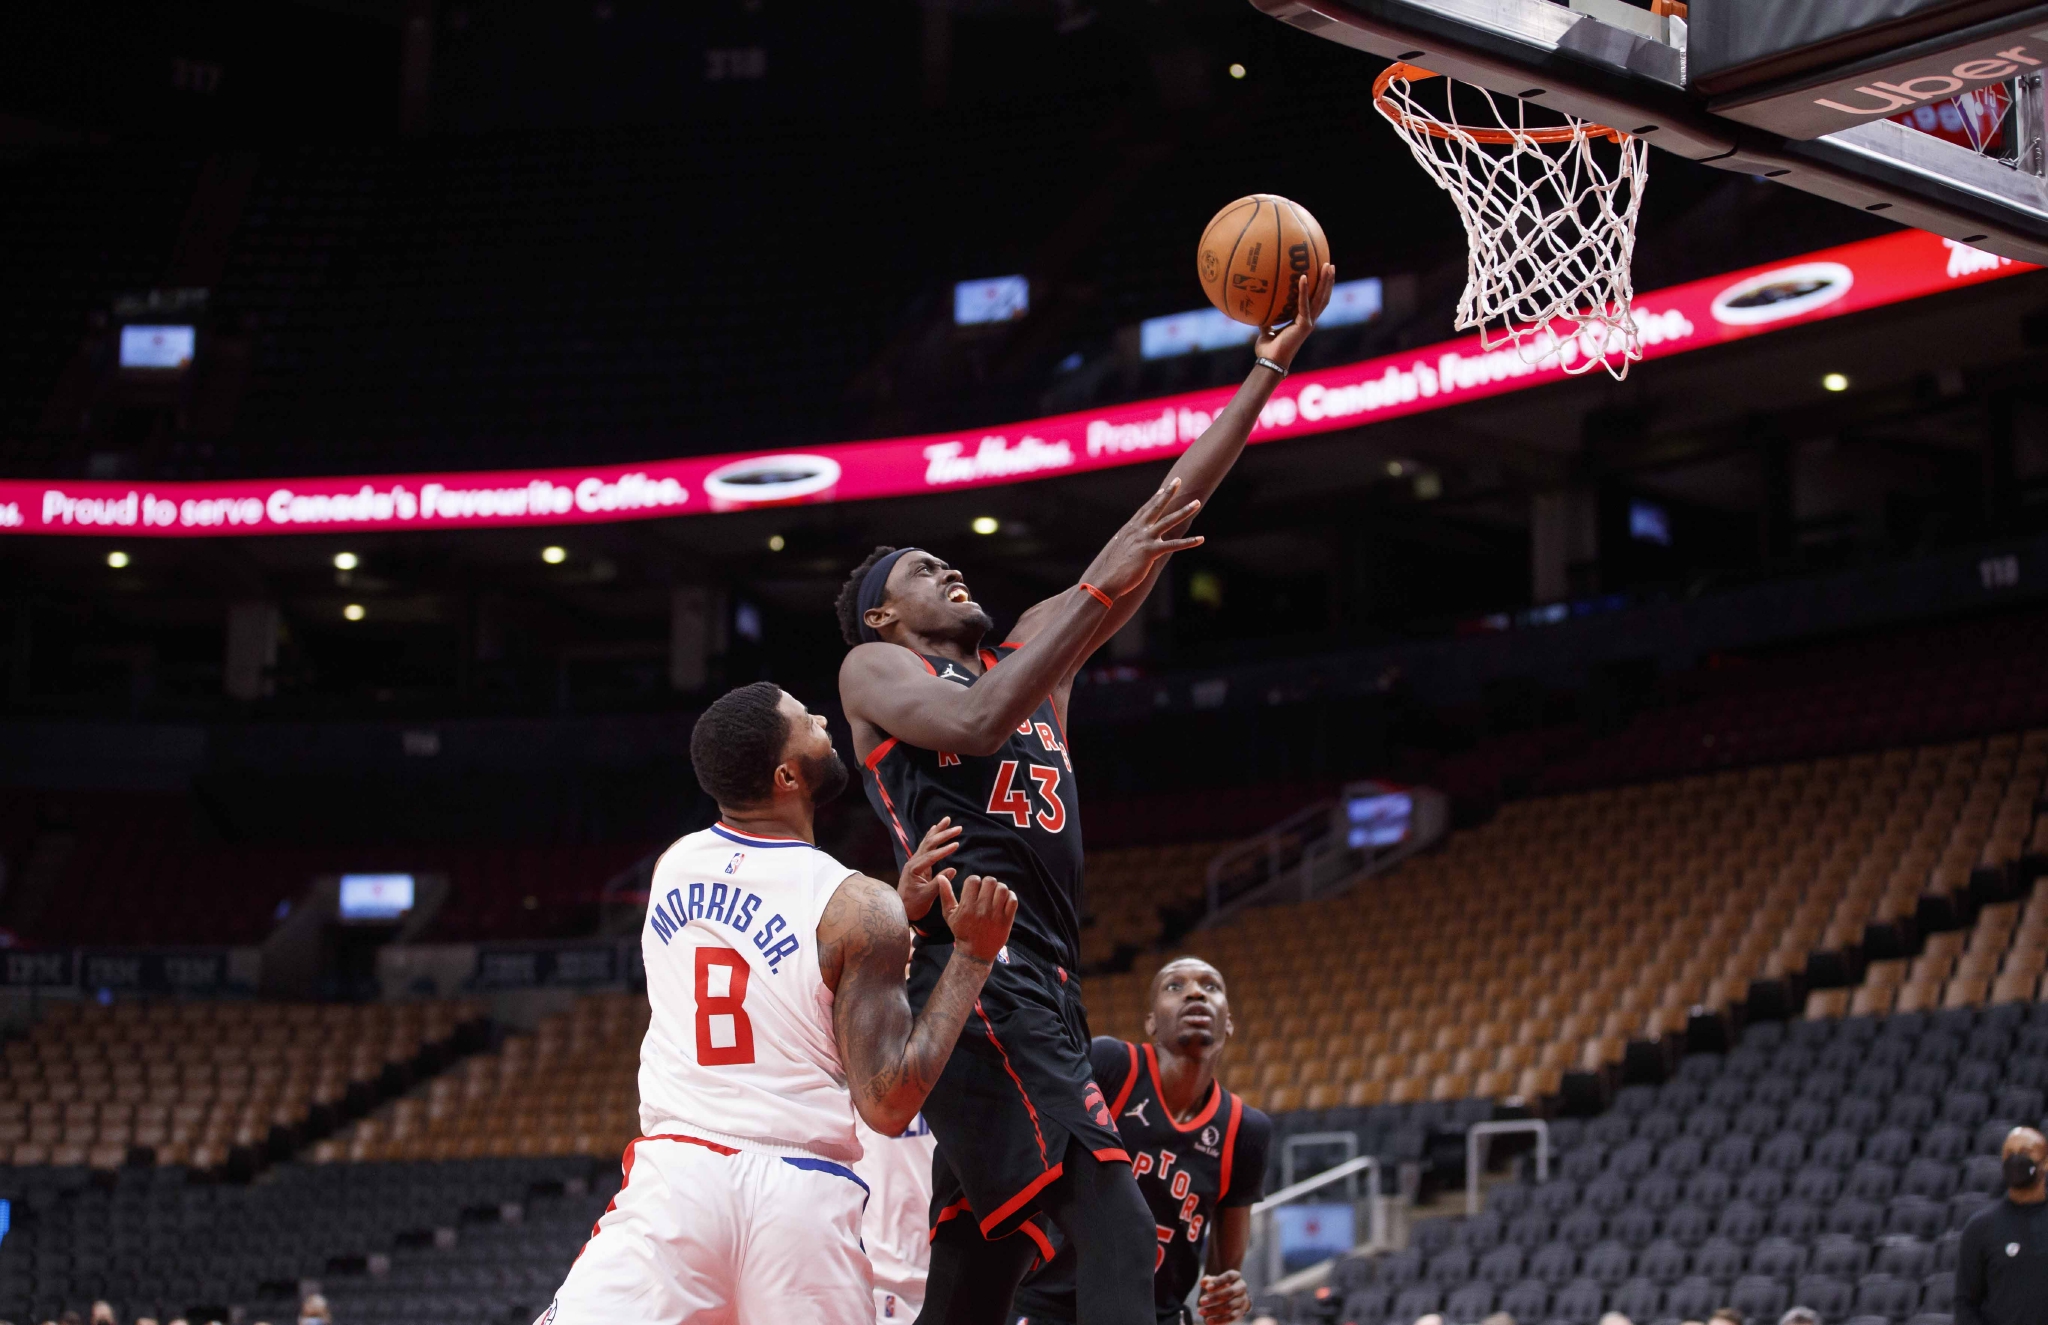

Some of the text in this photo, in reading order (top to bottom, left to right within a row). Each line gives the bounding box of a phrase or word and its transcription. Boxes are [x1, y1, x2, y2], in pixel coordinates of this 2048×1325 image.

[1813, 46, 2042, 115] Uber
[1087, 407, 1177, 457] Proud
[1297, 360, 1439, 422] Canada's
[42, 490, 138, 525] Proud
[142, 493, 177, 527] to
[180, 497, 264, 526] serve
[266, 489, 418, 522] Canada's
[420, 482, 573, 519] Favourite
[575, 472, 690, 513] Coffee.
[986, 760, 1066, 833] 43
[651, 882, 800, 975] MORRIS SR.
[695, 946, 755, 1066] 8
[1133, 1150, 1204, 1242] PTORS
